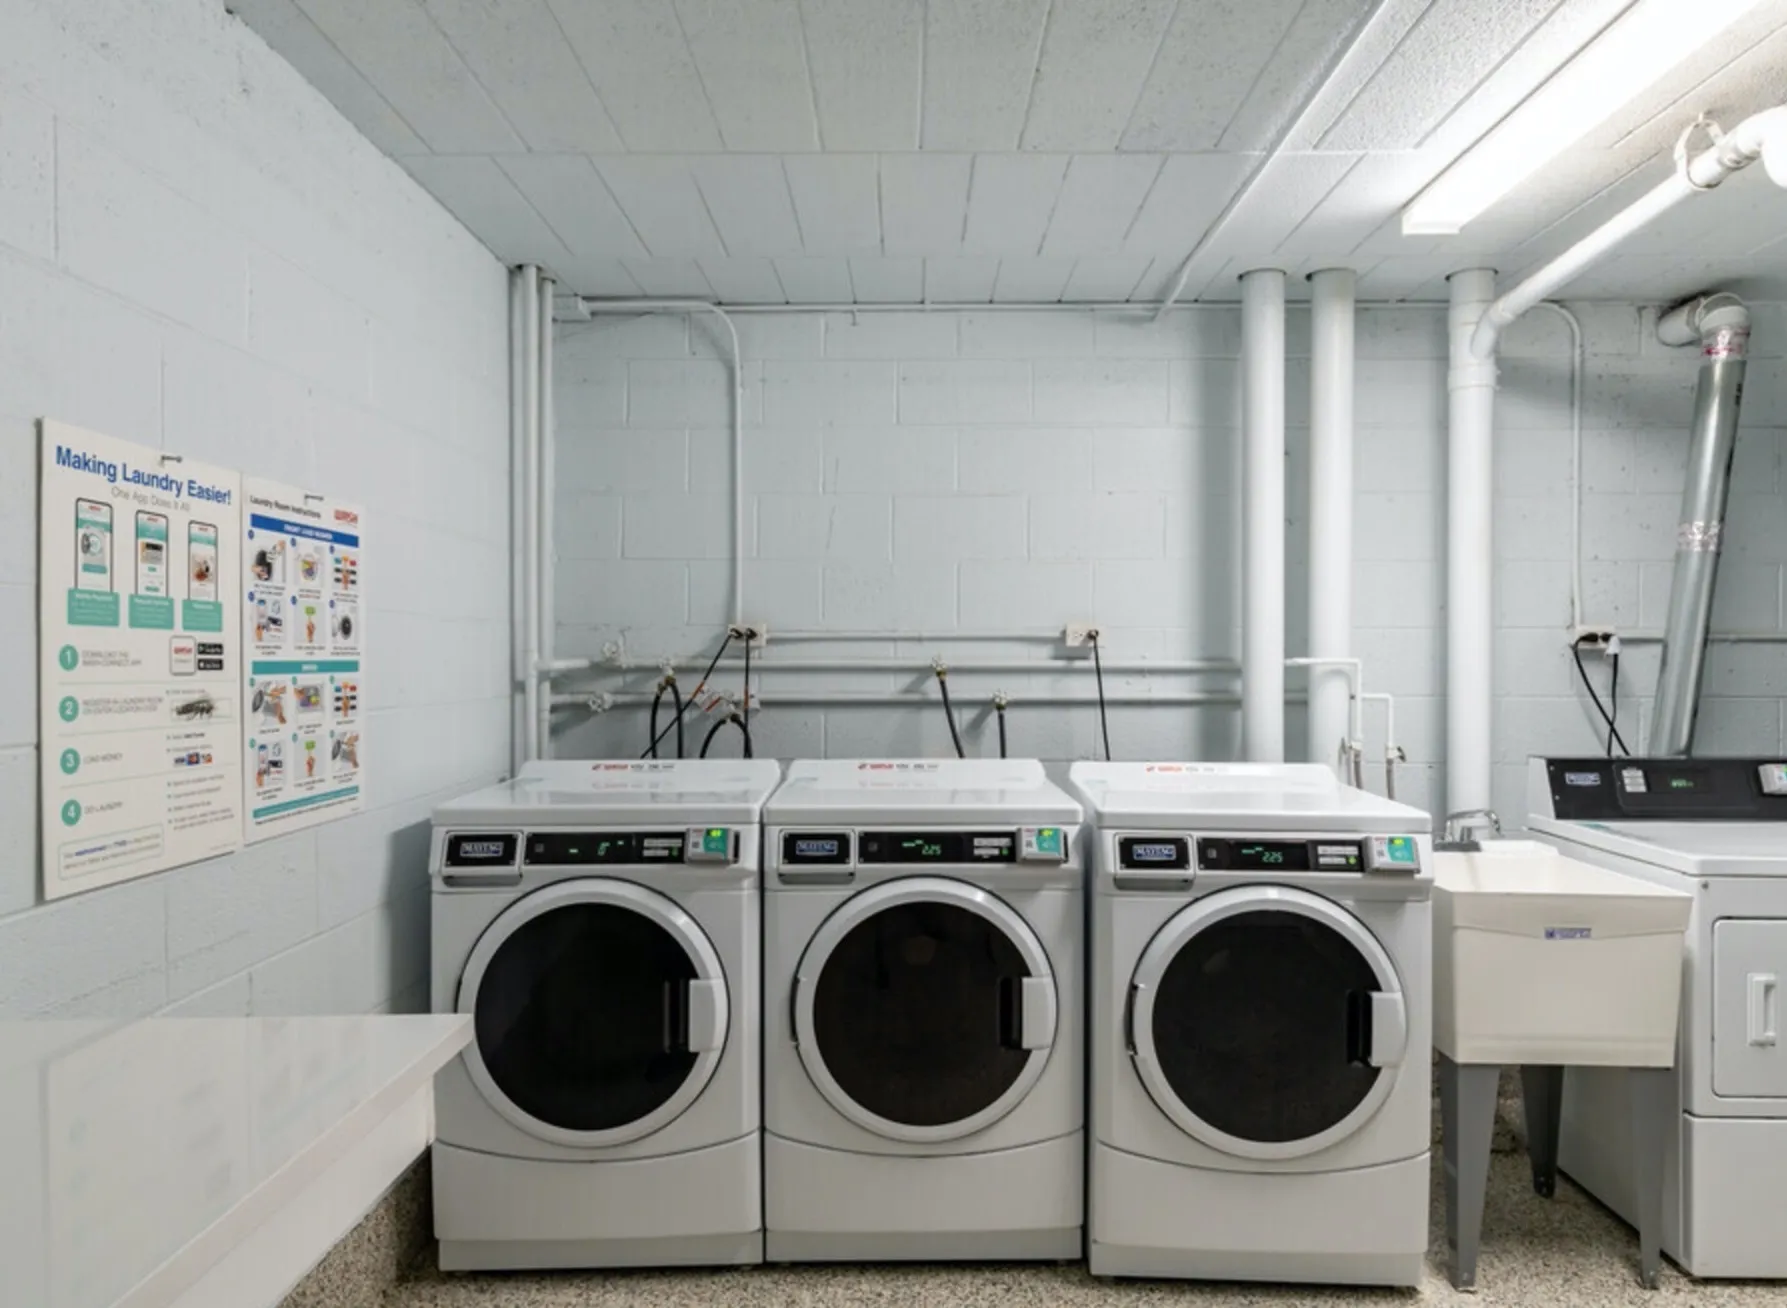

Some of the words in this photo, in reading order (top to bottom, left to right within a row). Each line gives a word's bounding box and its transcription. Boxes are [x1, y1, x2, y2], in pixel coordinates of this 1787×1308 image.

[56, 445, 117, 483] Making
[122, 463, 183, 498] Laundry
[187, 479, 231, 505] Easier!
[65, 650, 71, 665] 1
[65, 701, 73, 715] 2
[65, 753, 75, 767] 3
[67, 803, 76, 818] 4
